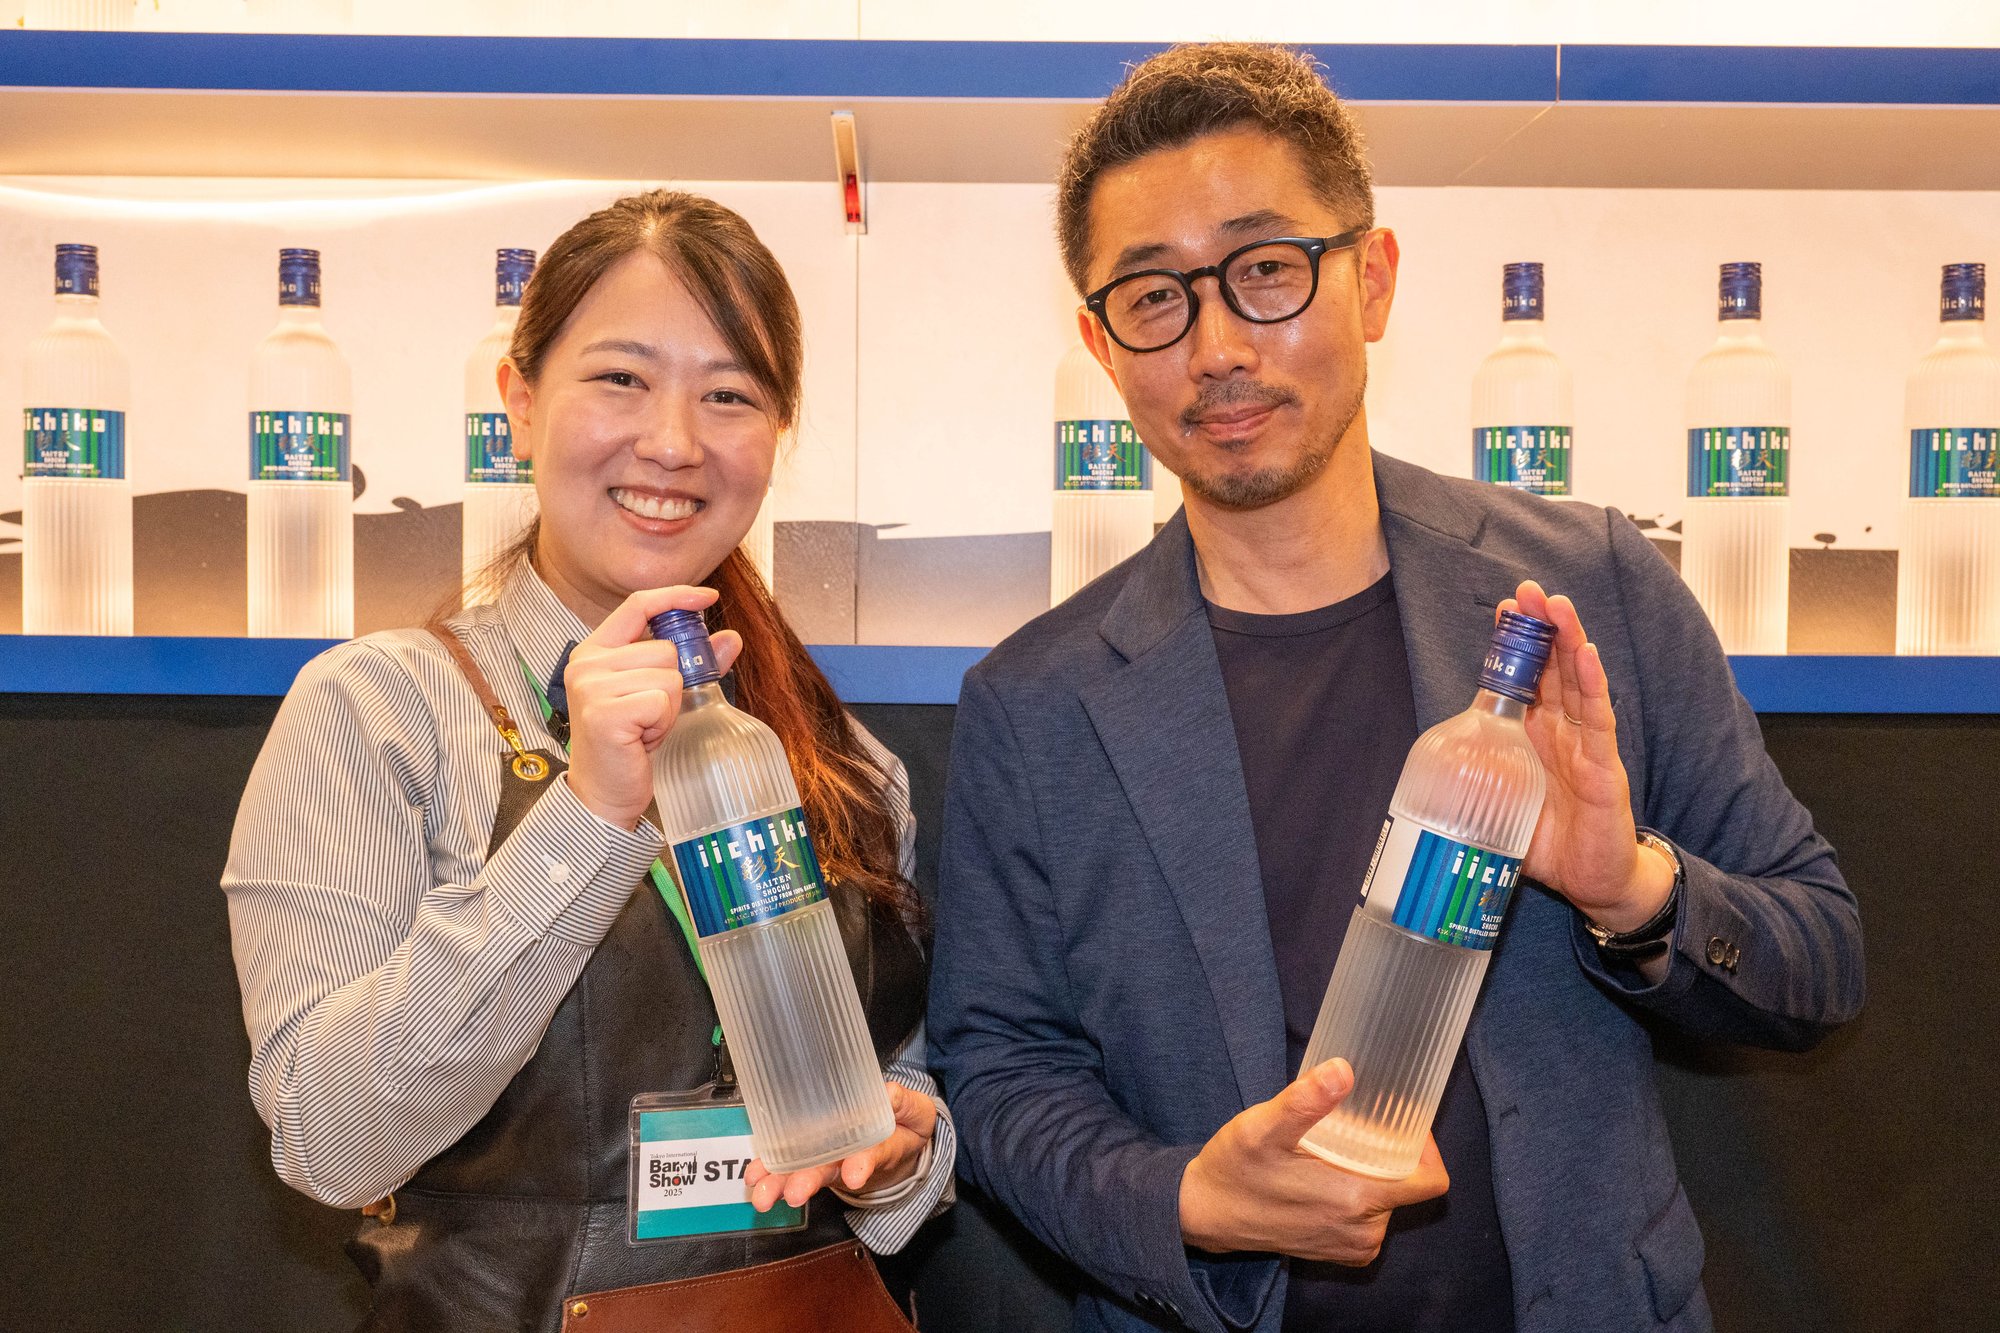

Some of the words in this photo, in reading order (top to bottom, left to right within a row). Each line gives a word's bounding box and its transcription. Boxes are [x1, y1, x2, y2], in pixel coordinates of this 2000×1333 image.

[255, 415, 343, 436] iichiko
[1485, 430, 1571, 449] iichiko
[1704, 431, 1789, 450] iichiko
[698, 819, 807, 868] iichiko
[756, 873, 792, 891] SAITEN
[762, 882, 790, 898] SHOCHU
[730, 903, 750, 915] SPIRITS
[751, 895, 778, 908] DISTILLED
[779, 890, 793, 900] FROM
[1449, 922, 1469, 933] SPIRITS
[666, 1150, 698, 1159] International
[650, 1159, 681, 1174] Bar
[649, 1173, 697, 1189] Show
[663, 1187, 683, 1197] 2025
